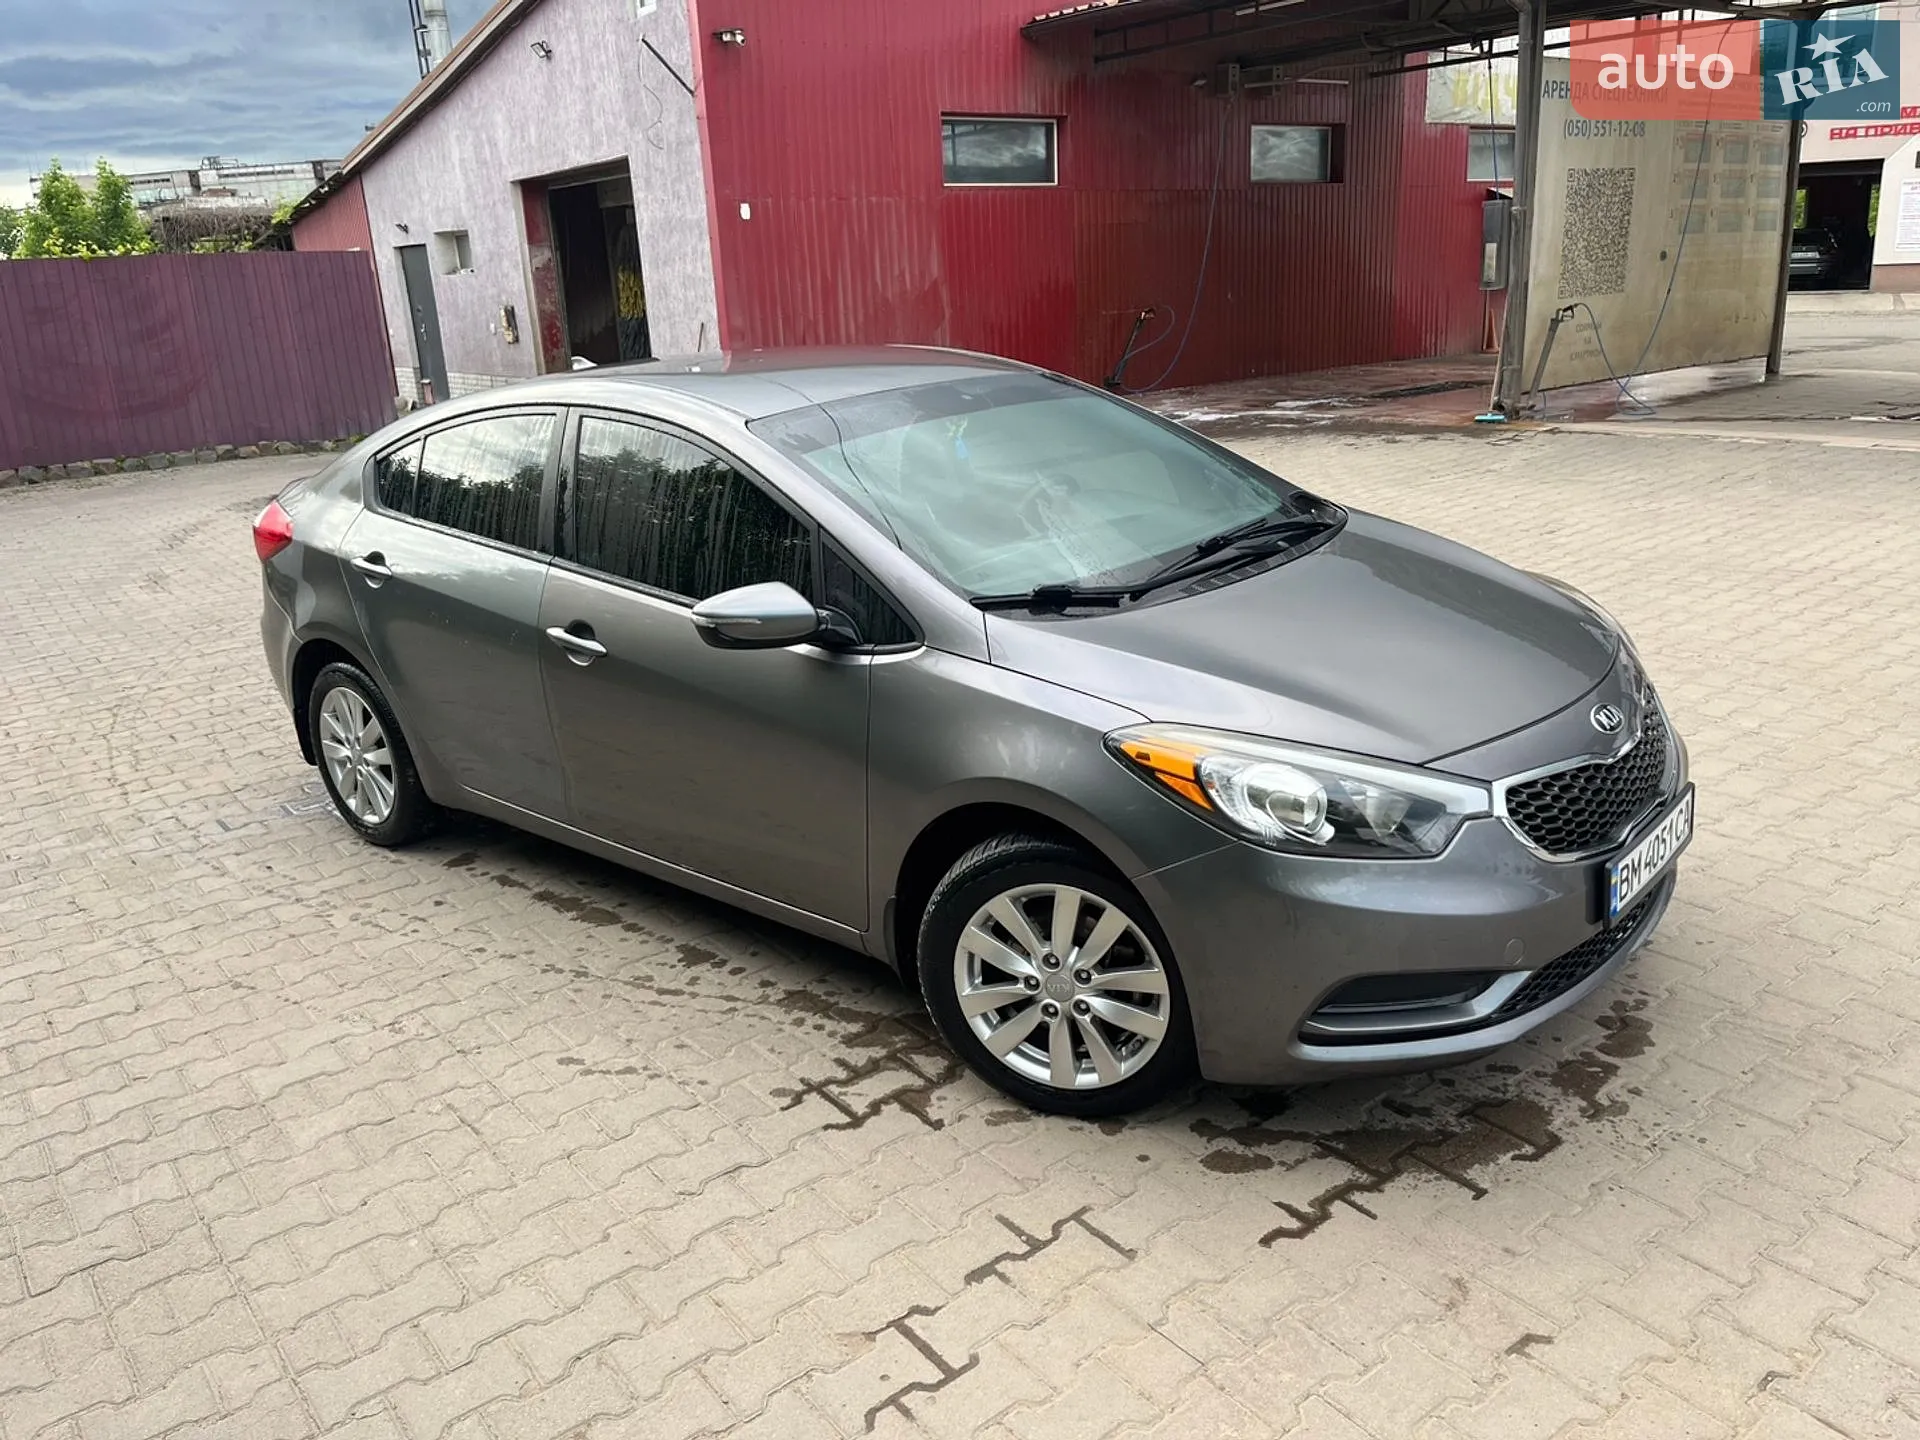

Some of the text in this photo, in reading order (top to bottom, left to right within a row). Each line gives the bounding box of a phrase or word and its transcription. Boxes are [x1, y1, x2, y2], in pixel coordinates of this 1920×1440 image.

[1542, 80, 1589, 103] АРЕНДА
[1564, 120, 1646, 139] (050) 551-12-08
[1595, 706, 1619, 729] KIA
